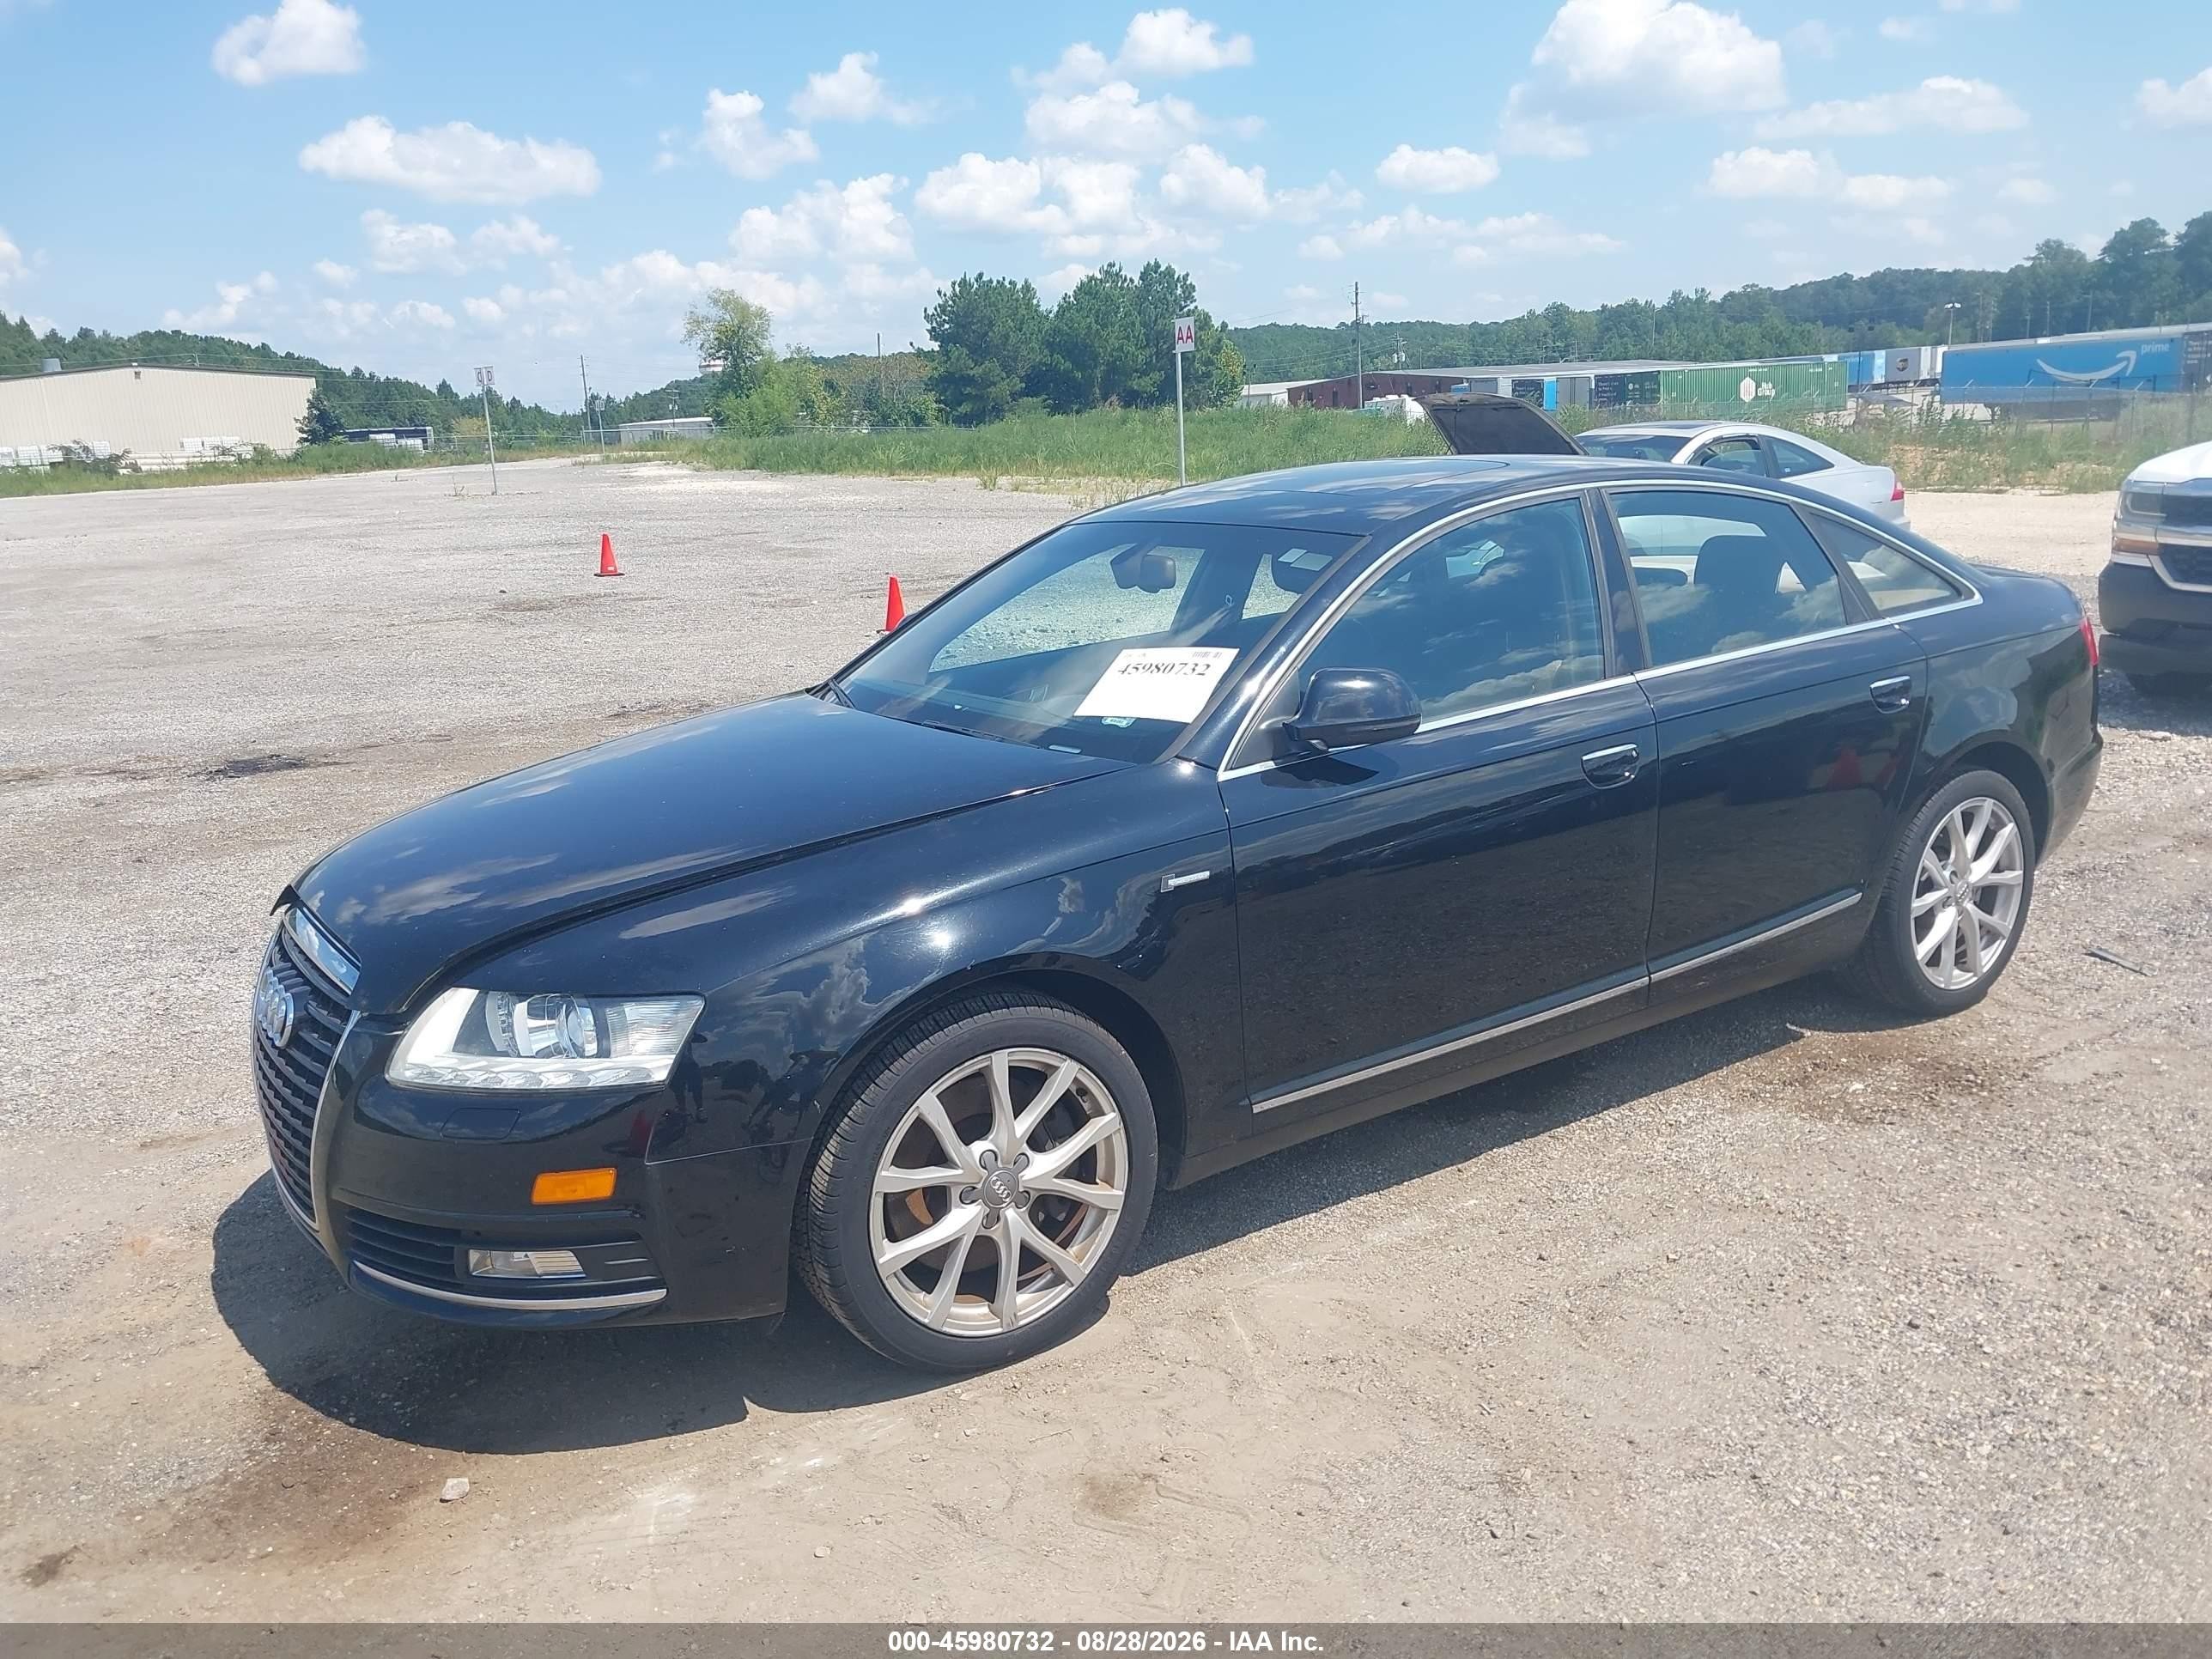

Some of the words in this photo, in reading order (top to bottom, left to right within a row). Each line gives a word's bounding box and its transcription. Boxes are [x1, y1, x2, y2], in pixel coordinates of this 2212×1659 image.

[1176, 325, 1194, 344] AA
[2141, 342, 2170, 356] prime
[1118, 662, 1212, 677] 45980732
